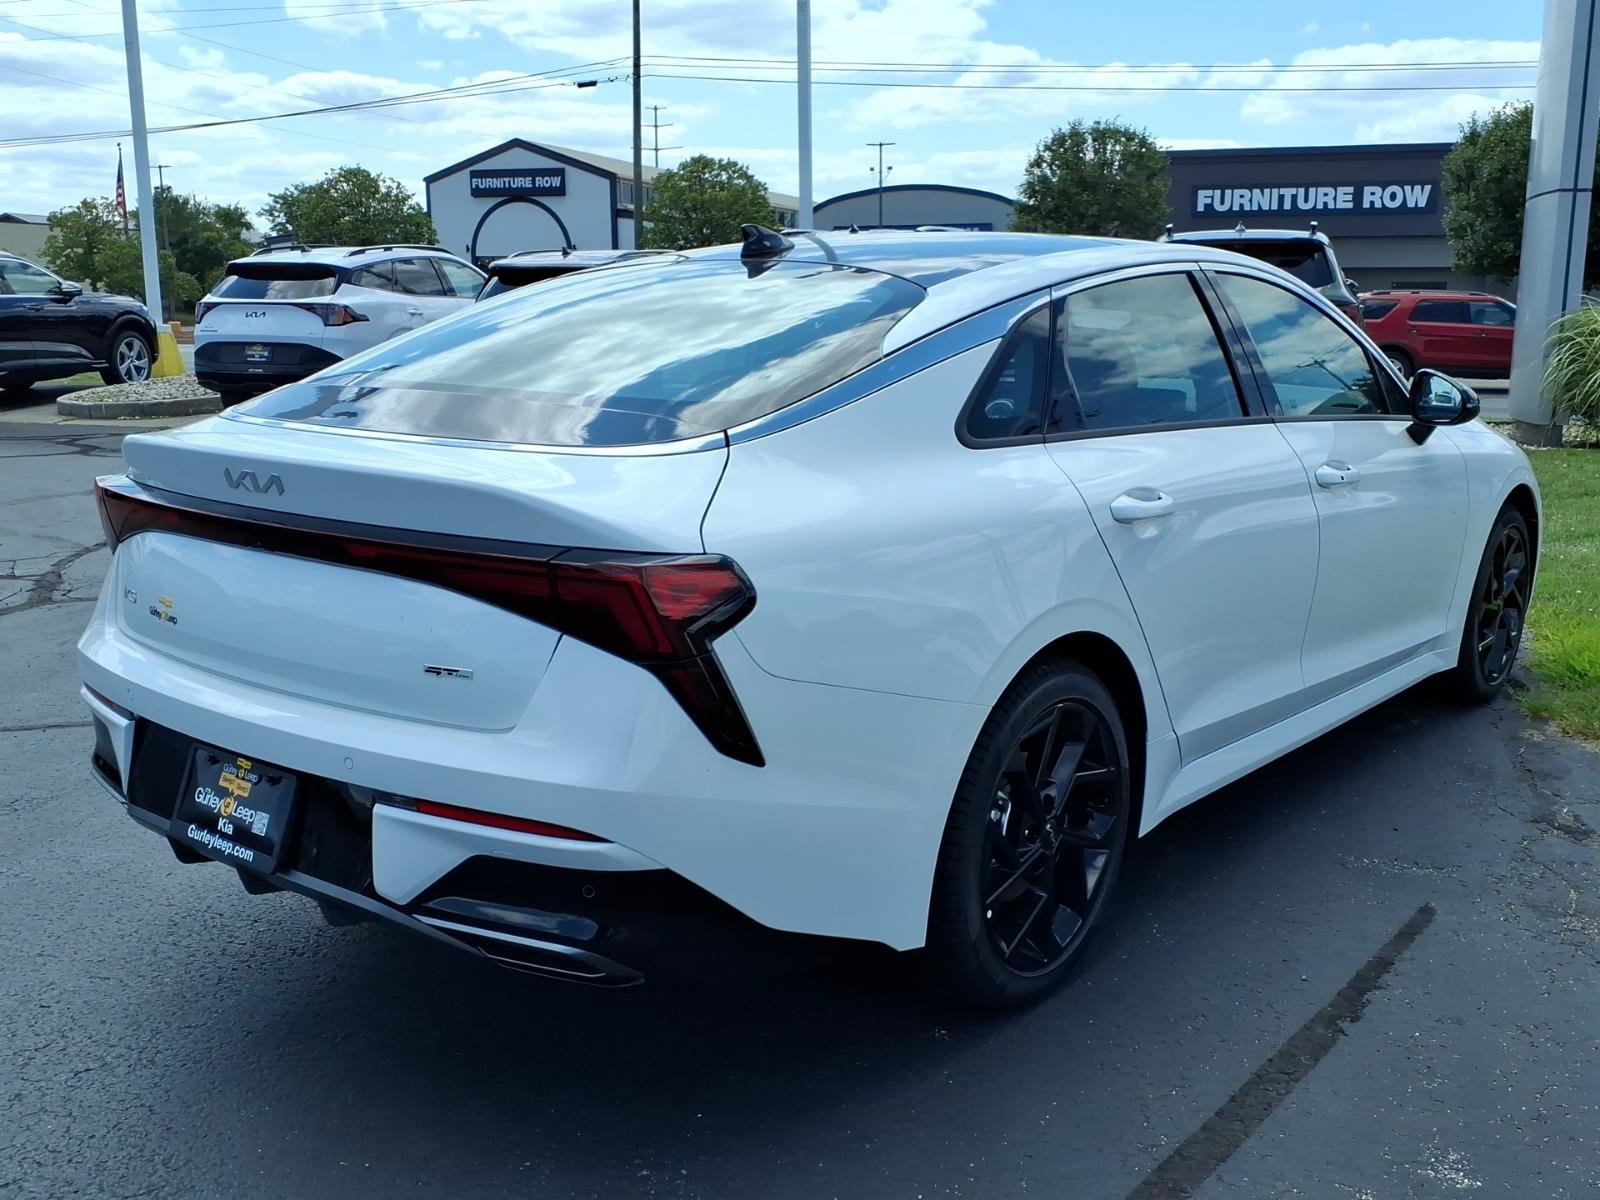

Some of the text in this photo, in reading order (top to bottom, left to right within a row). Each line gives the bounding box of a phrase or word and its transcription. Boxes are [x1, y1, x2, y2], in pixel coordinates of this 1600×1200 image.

[472, 176, 561, 188] FURNITURE ROW
[1197, 185, 1432, 211] FURNITURE ROW
[195, 787, 222, 812] Gurley
[232, 801, 256, 825] Leep
[217, 817, 234, 835] Kia
[187, 824, 254, 862] Gurleyleep.com
